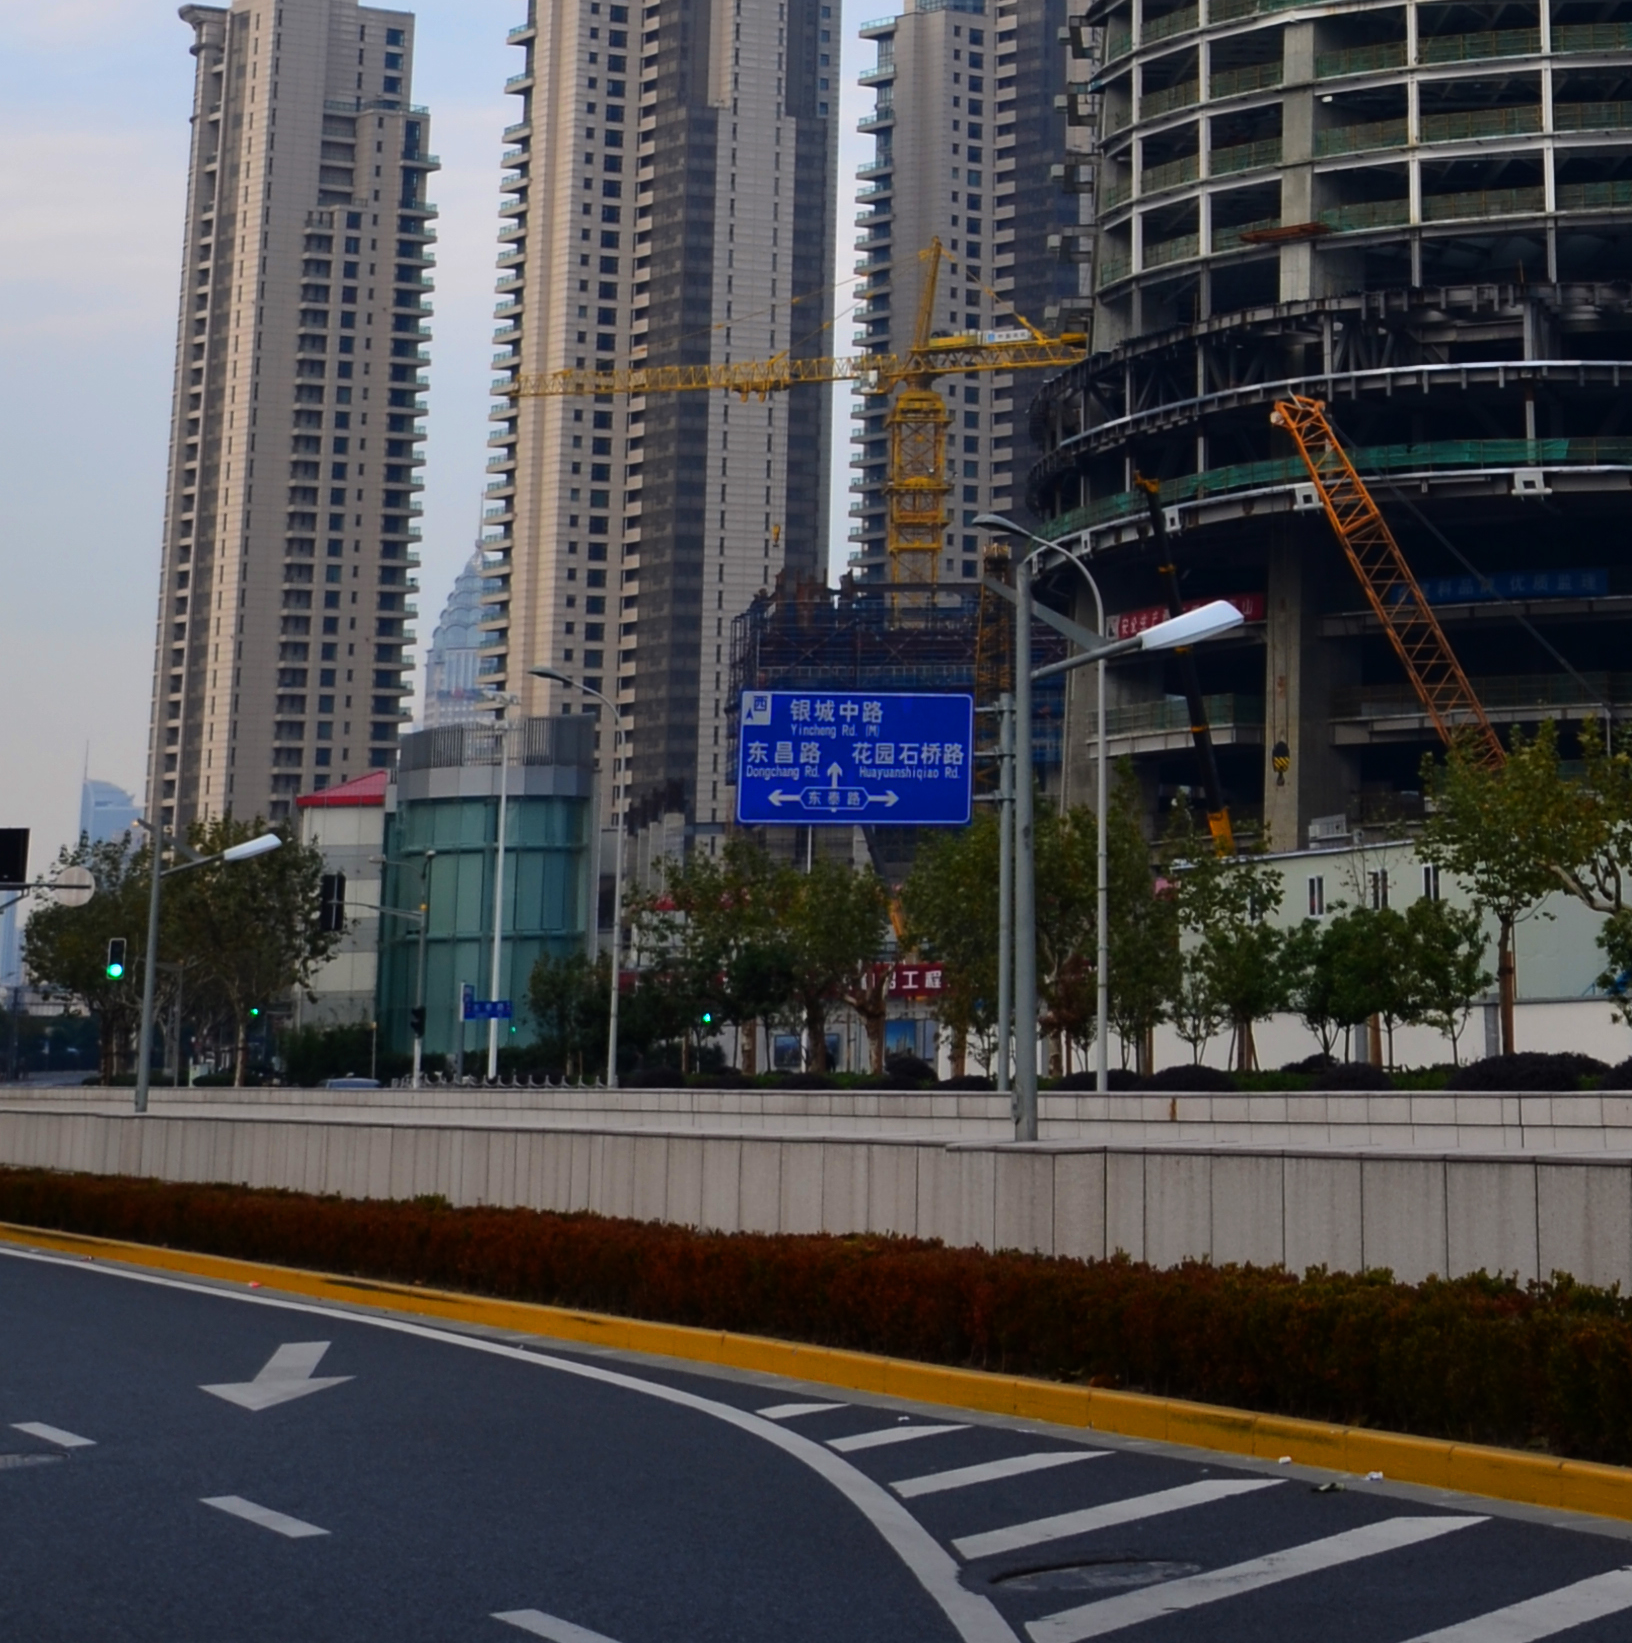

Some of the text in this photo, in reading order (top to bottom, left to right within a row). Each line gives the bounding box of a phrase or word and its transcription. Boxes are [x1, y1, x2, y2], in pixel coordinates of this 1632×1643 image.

[1510, 573, 1597, 593] 优质监理
[754, 696, 767, 711] 西
[790, 698, 883, 723] 银城中路
[791, 724, 880, 739] Yincheng Rd. (M)
[747, 741, 821, 765] 东昌路
[852, 742, 964, 765] 花园石桥路
[746, 765, 819, 781] Dongchang Rd.
[859, 766, 961, 781] Huayuanshiqiao Rd.
[808, 791, 861, 806] 东泰路
